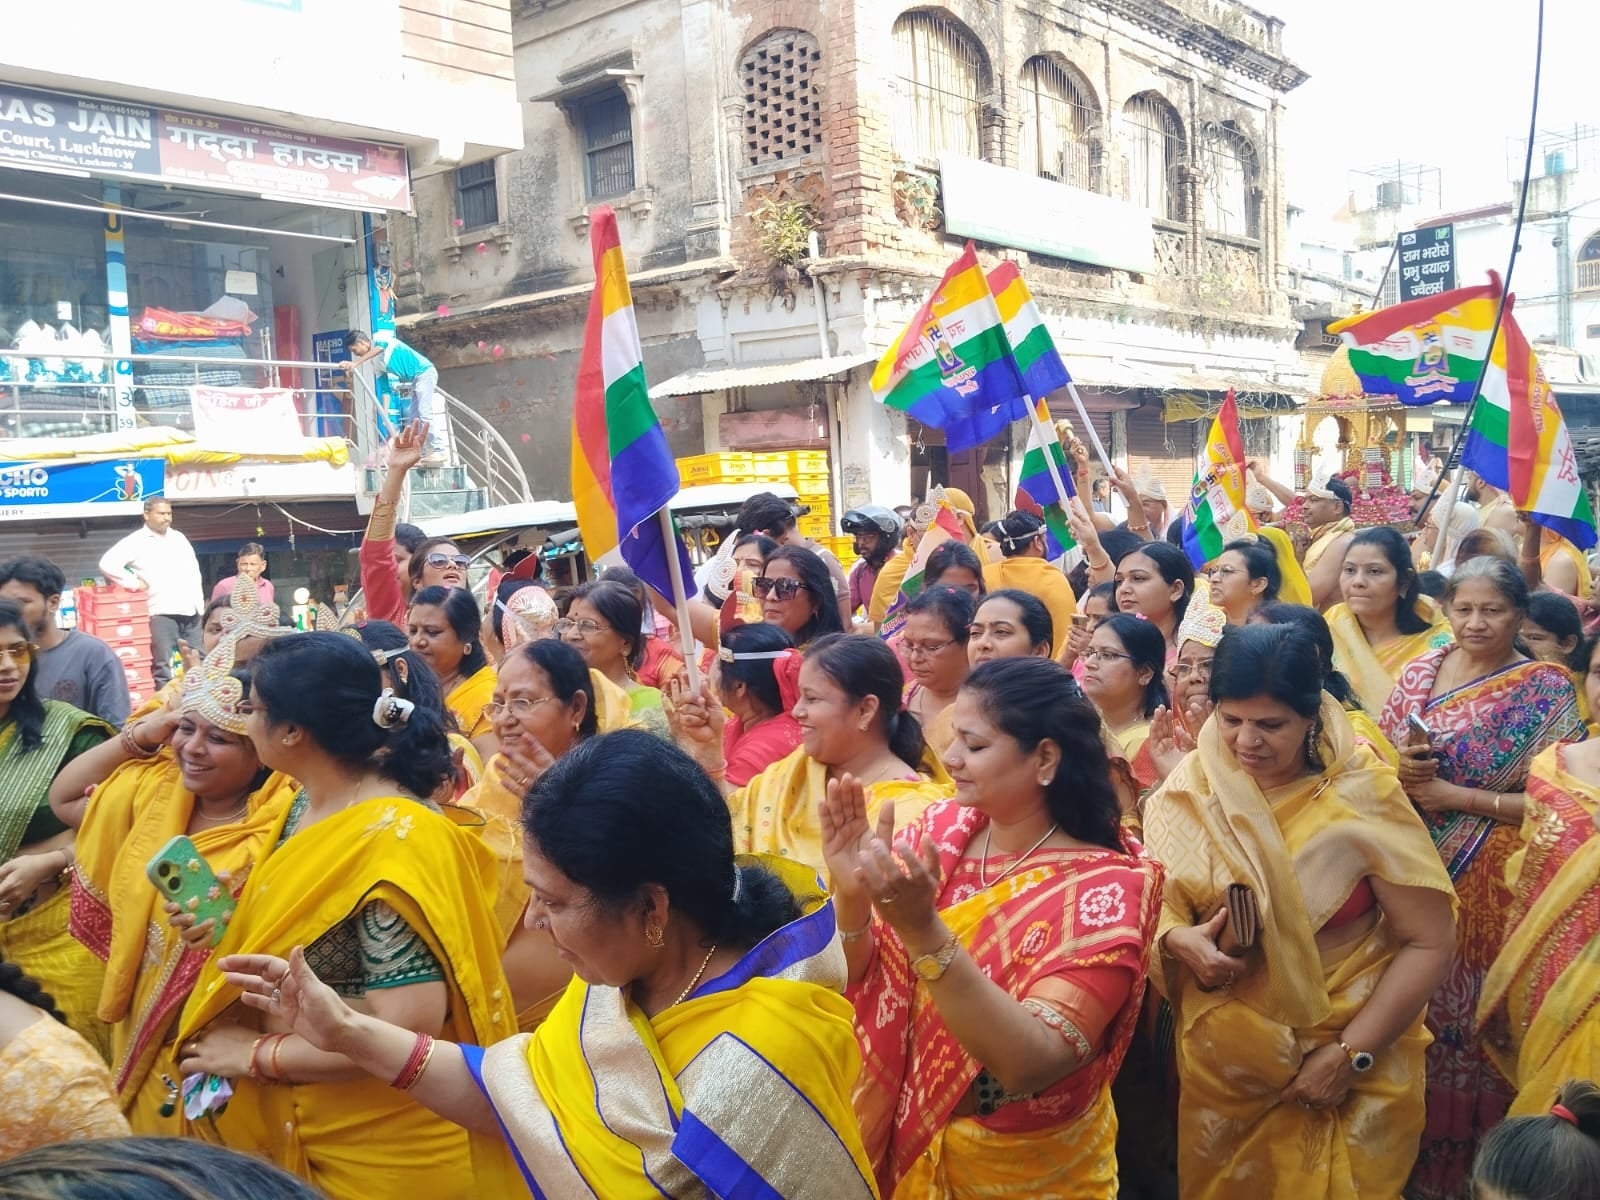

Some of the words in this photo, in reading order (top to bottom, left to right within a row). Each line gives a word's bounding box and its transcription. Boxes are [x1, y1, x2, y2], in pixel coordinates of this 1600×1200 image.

[68, 109, 152, 141] JAIN
[0, 129, 55, 152] Court,
[59, 137, 136, 161] Lucknow
[100, 134, 151, 150] Advocate
[268, 139, 362, 174] हाउस
[1402, 249, 1420, 262] राम
[1422, 241, 1449, 259] भरोसे
[1403, 265, 1420, 281] प्रभु
[1421, 261, 1450, 275] दयाल
[4, 487, 48, 497] SPORTO
